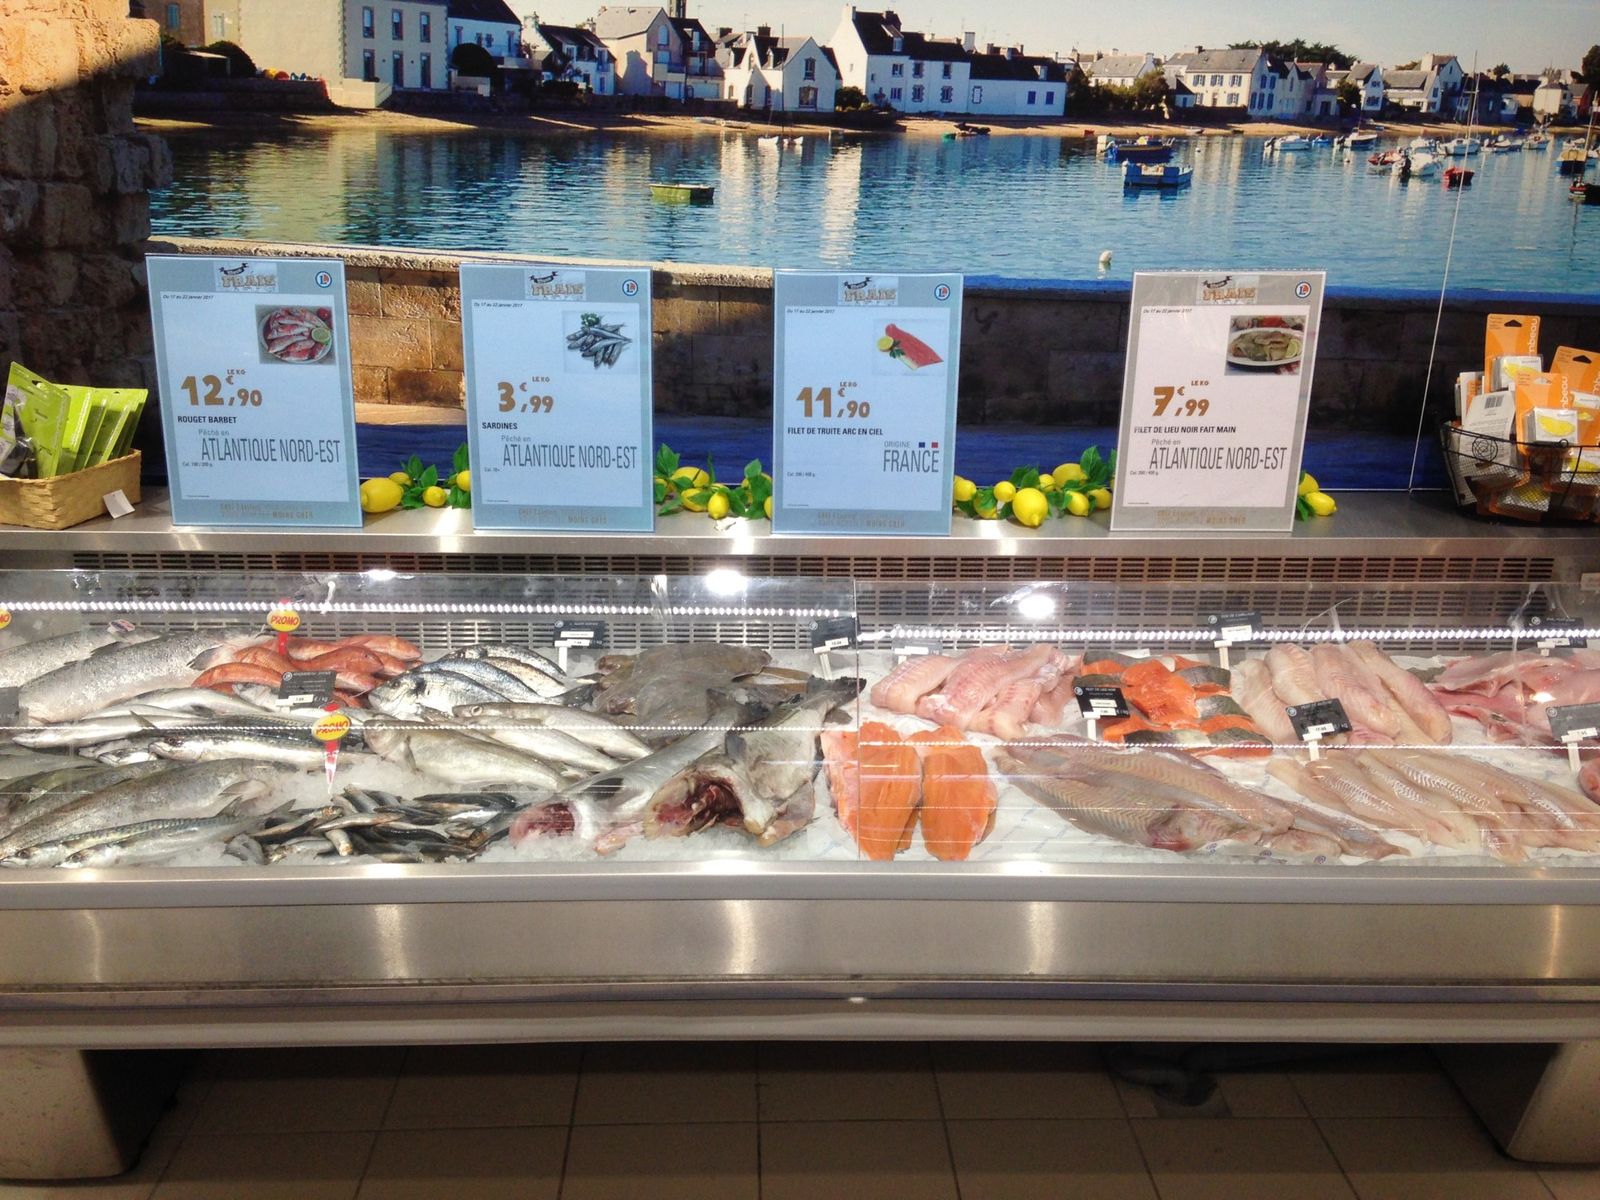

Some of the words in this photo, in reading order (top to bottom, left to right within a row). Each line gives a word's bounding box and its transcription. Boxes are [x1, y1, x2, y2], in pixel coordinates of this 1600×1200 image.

[201, 438, 277, 462] ATLANTIQUE
[280, 439, 340, 463] NORD-EST
[503, 444, 575, 468] ATLANTIQUE
[579, 445, 637, 469] NORD-EST
[883, 450, 939, 473] FRANCE
[1150, 447, 1224, 470] ATLANTIQUE
[1226, 447, 1287, 470] NORD-EST
[271, 616, 298, 626] PROMO
